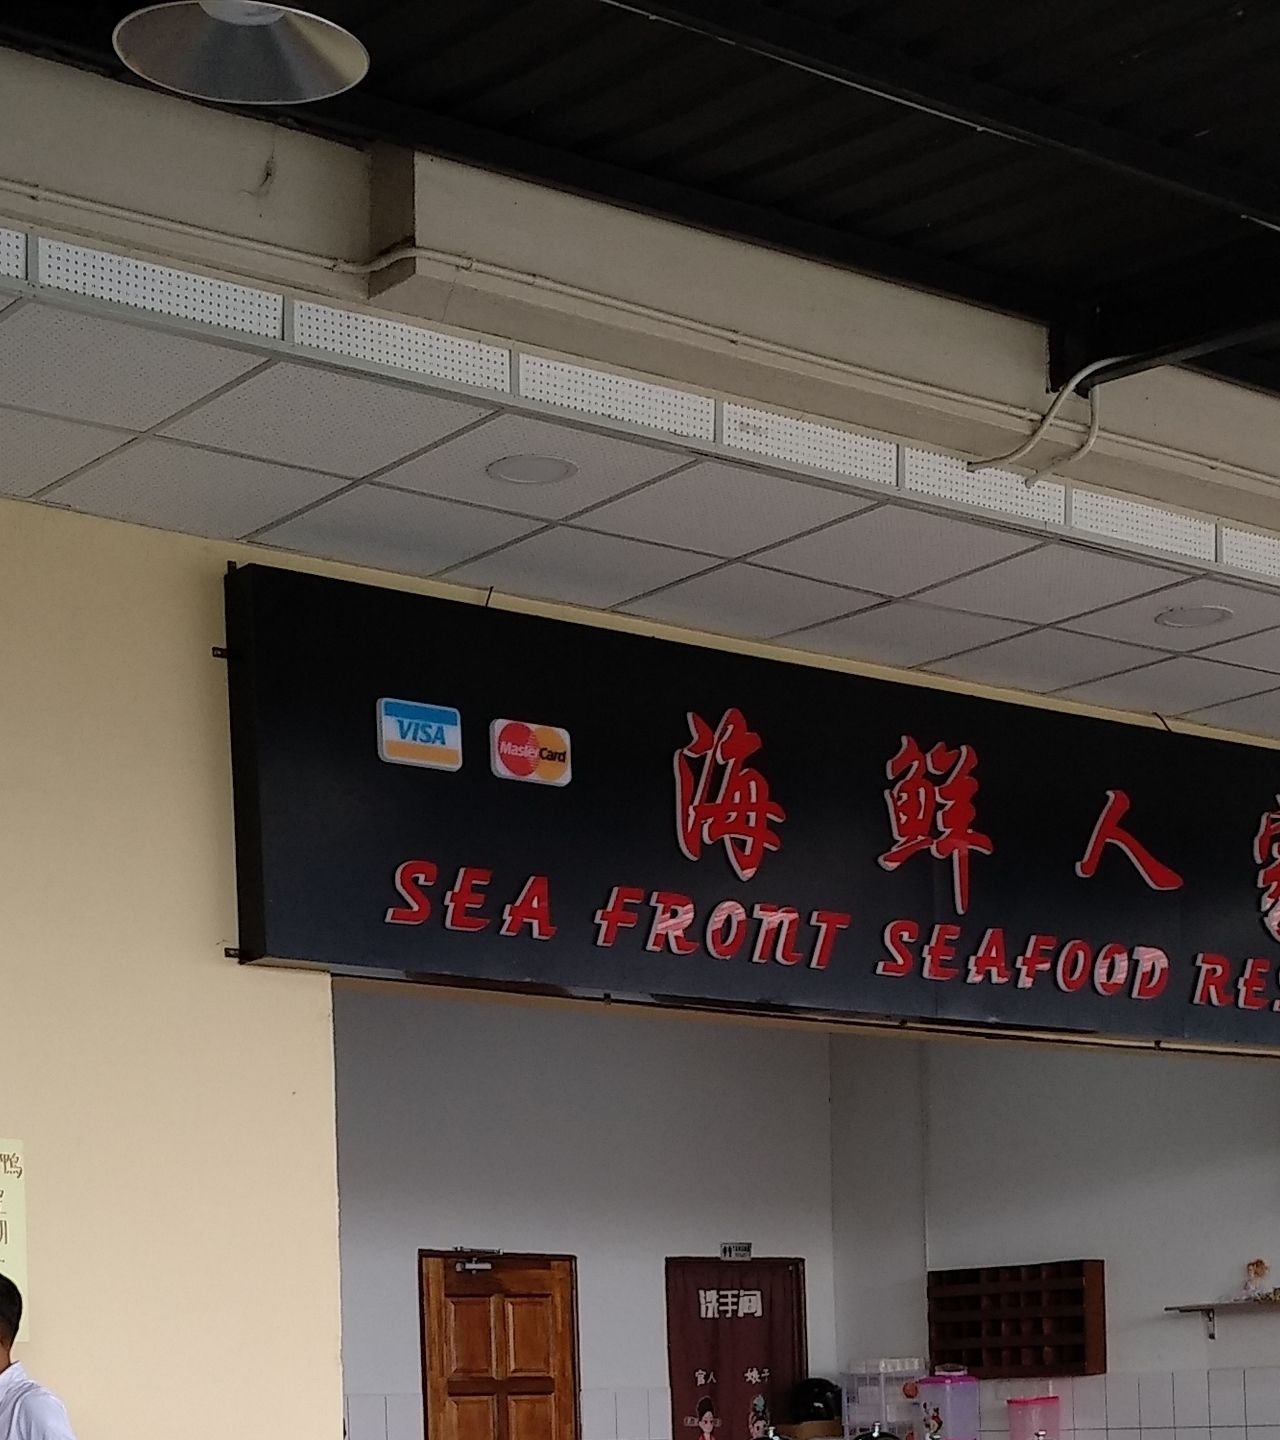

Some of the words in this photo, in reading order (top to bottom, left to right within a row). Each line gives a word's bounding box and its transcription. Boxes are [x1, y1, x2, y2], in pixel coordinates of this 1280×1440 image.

[394, 719, 447, 747] VISA
[498, 740, 568, 765] MasterCard
[385, 859, 557, 940] SEA
[594, 885, 851, 970] FRONT
[876, 920, 1170, 1001] SEAFOOD
[698, 1288, 764, 1319] 洗手间
